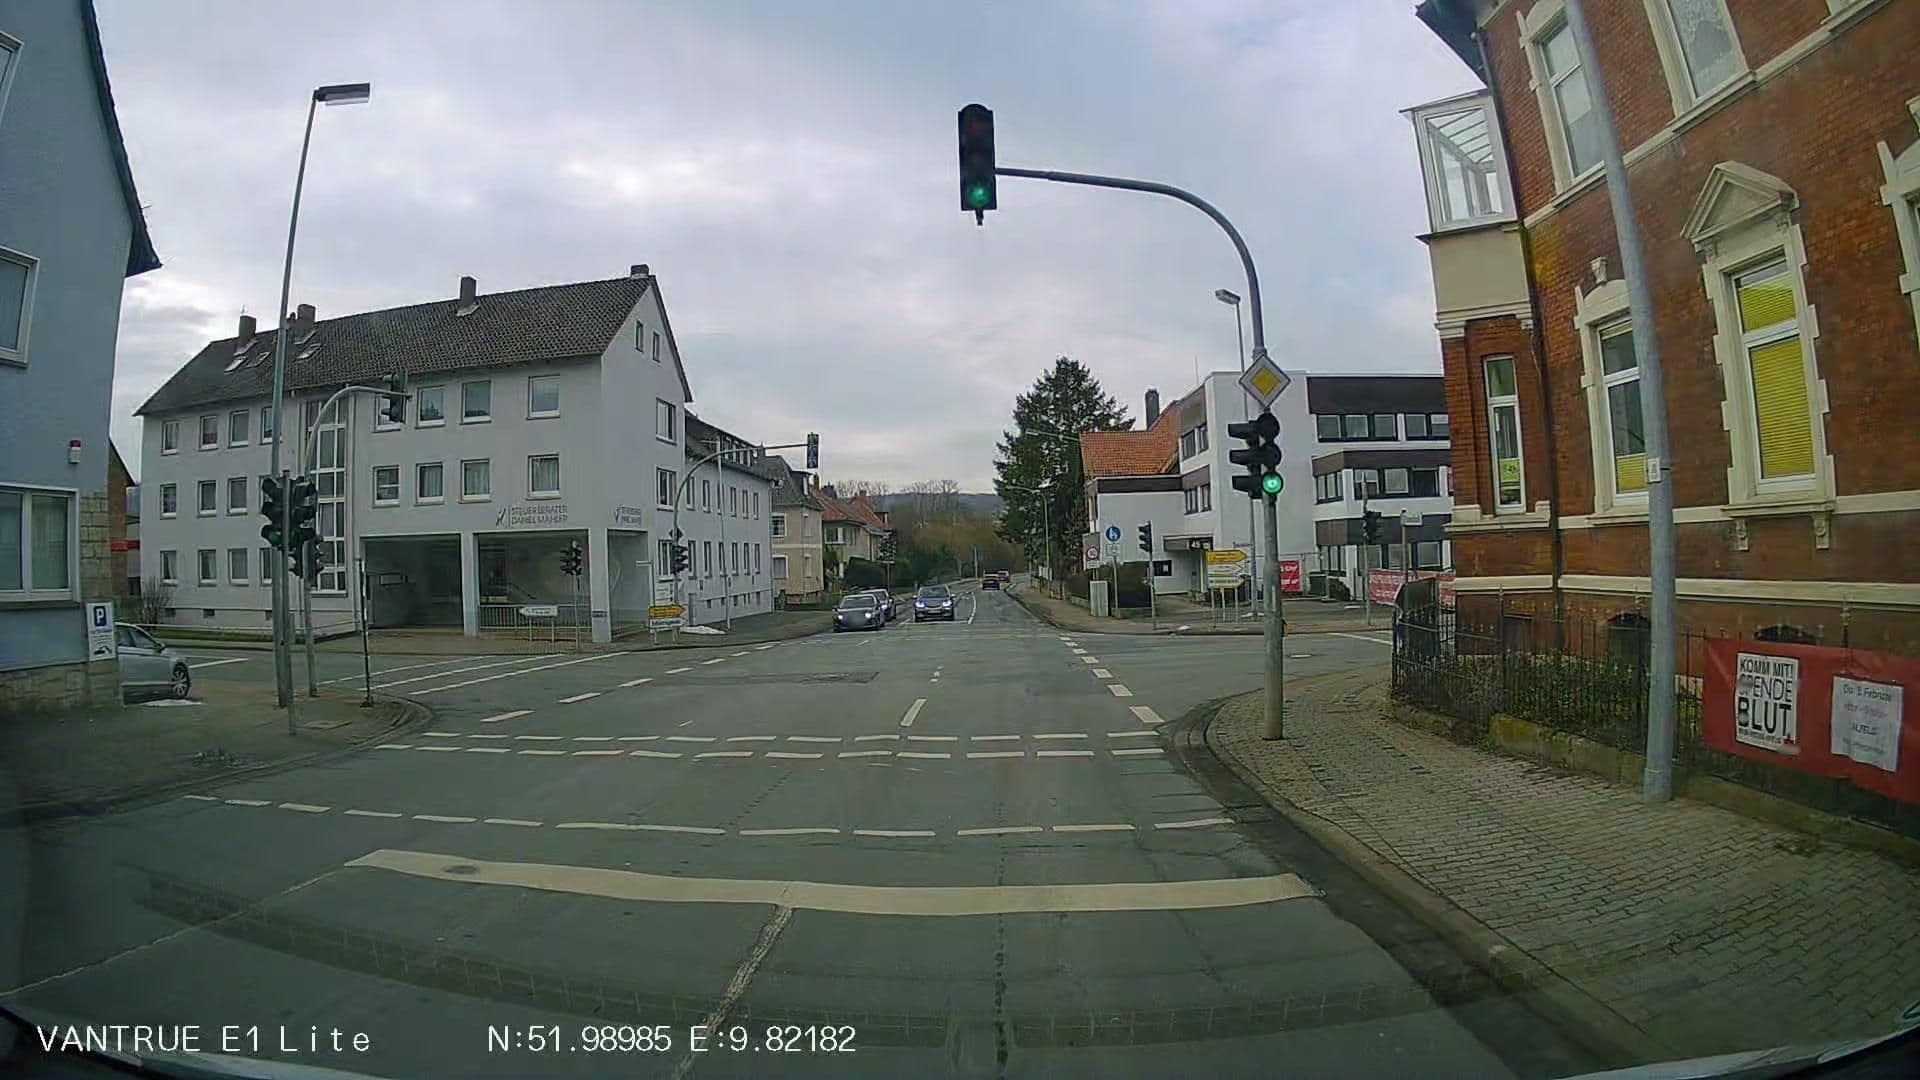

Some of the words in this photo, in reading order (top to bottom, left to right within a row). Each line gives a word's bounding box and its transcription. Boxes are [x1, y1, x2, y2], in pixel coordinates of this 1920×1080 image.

[96, 608, 104, 624] P
[1739, 658, 1770, 674] KOMM
[1772, 662, 1794, 678] MIT!
